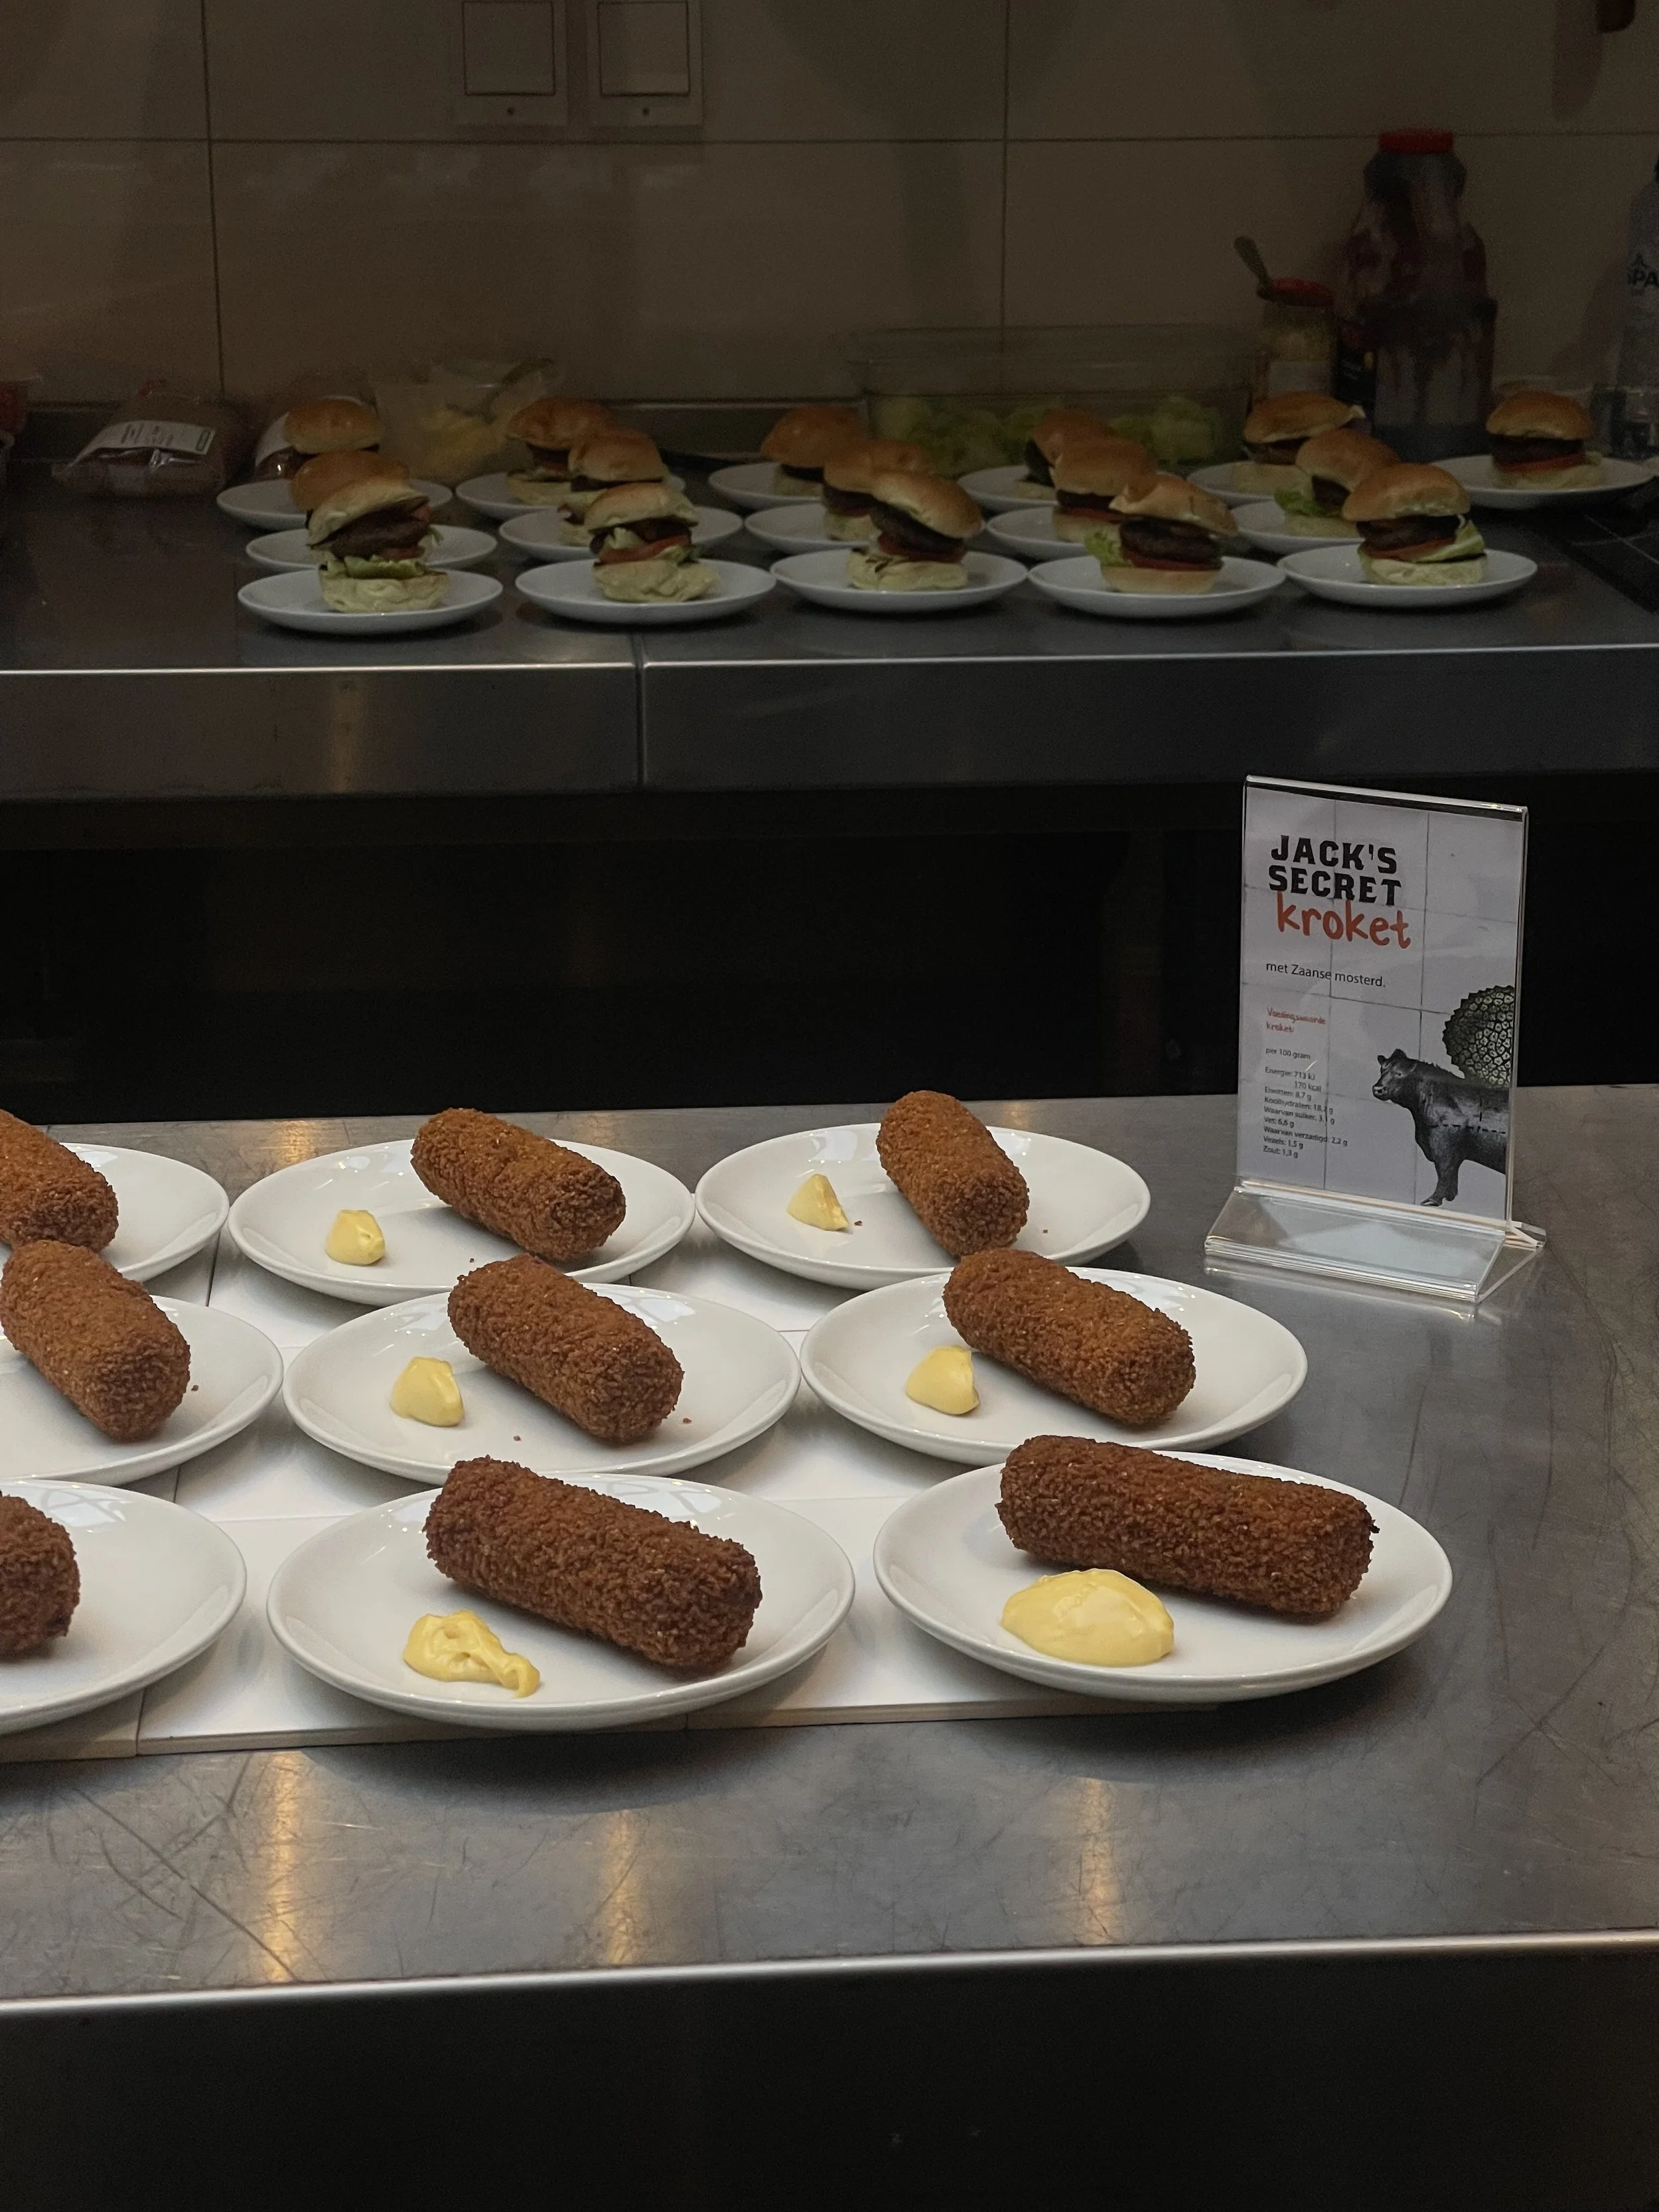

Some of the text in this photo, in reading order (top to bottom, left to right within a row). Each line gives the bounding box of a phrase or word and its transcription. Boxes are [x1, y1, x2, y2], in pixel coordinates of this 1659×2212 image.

[1270, 834, 1398, 875] JACK'S
[1267, 864, 1402, 907] SECRET
[1276, 890, 1411, 949] kroket
[1266, 962, 1386, 988] met Zaanse mosterd.
[1267, 1021, 1293, 1032] kroket
[1293, 1051, 1311, 1060] gram
[1265, 1067, 1292, 1077] Energie:
[1295, 1080, 1322, 1092] 170 kcal
[1264, 1096, 1312, 1110] Koolhydraten:
[1264, 1106, 1293, 1116] Waarvan
[1263, 1126, 1293, 1136] Waarvan
